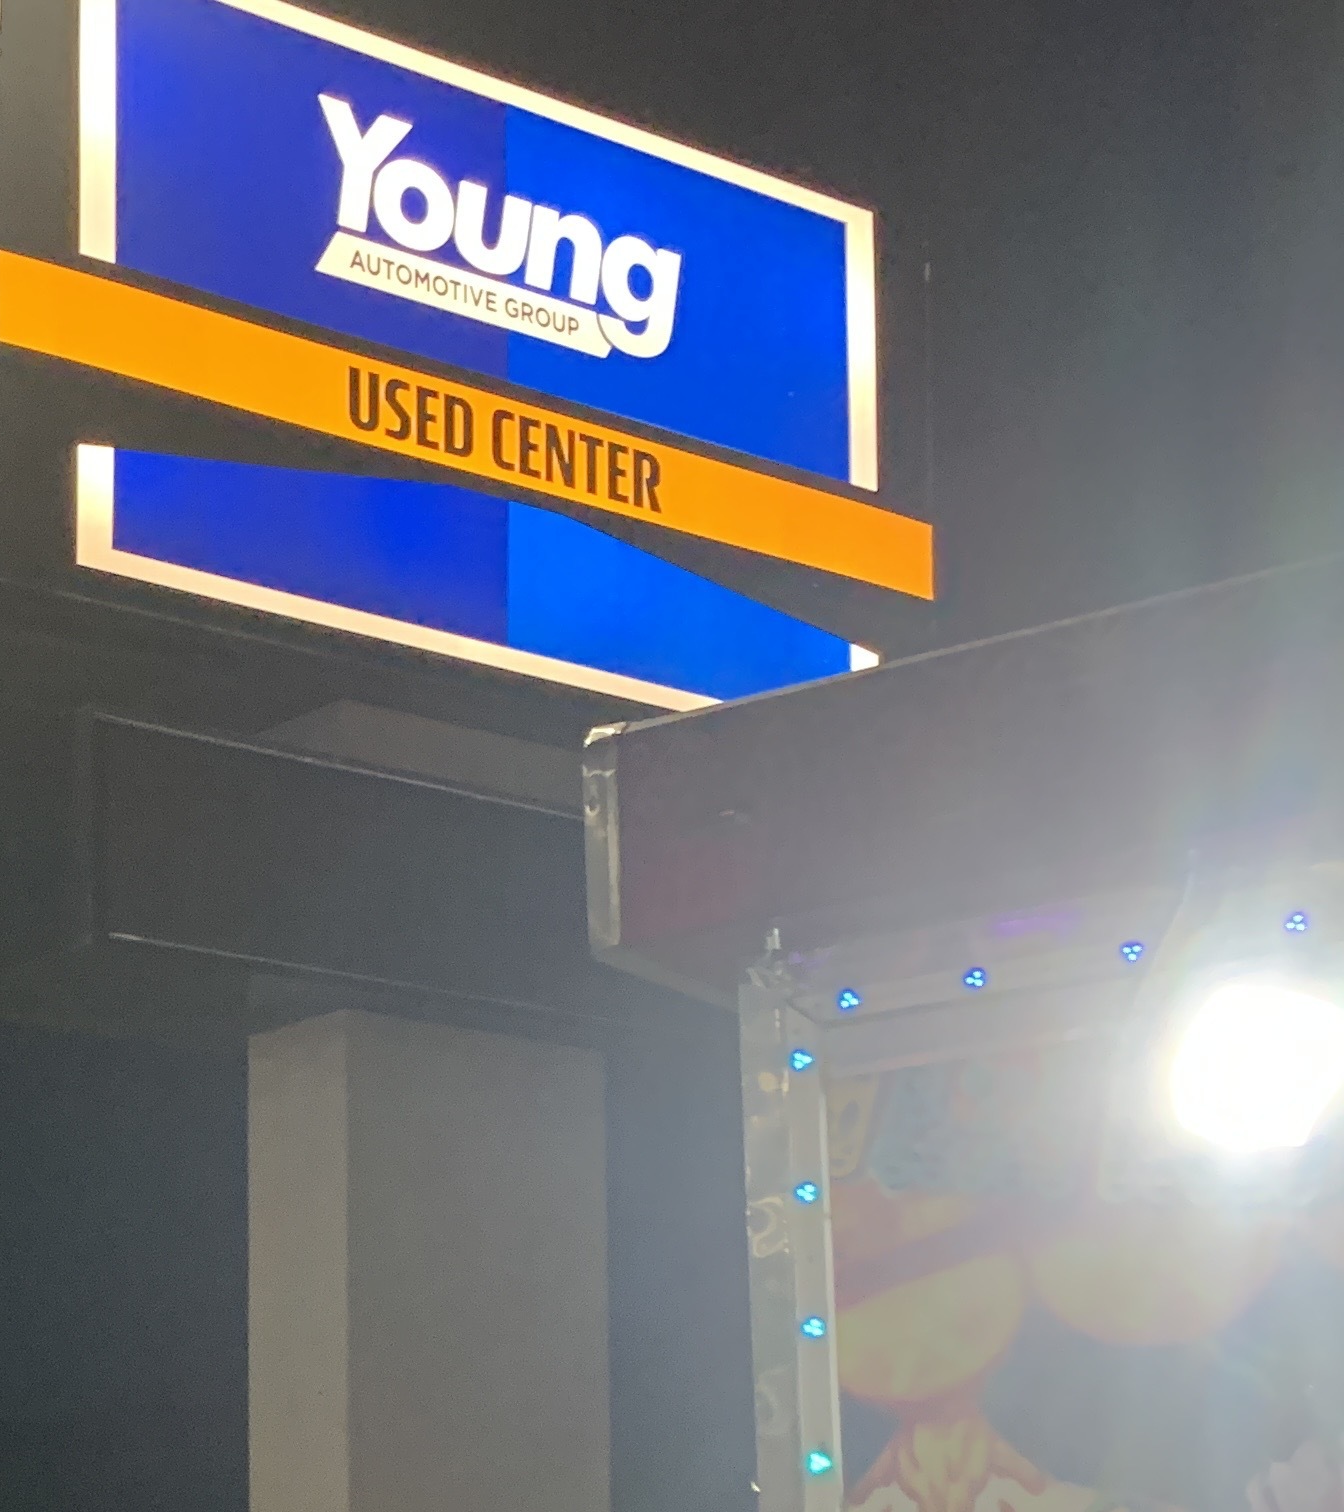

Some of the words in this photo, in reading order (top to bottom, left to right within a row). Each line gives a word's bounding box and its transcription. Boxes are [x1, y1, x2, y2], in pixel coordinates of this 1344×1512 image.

[318, 93, 681, 358] Young
[349, 250, 498, 312] AUTOMOTIVE
[505, 298, 579, 335] GROUP
[348, 366, 474, 458] USED
[491, 409, 662, 513] CENTER
